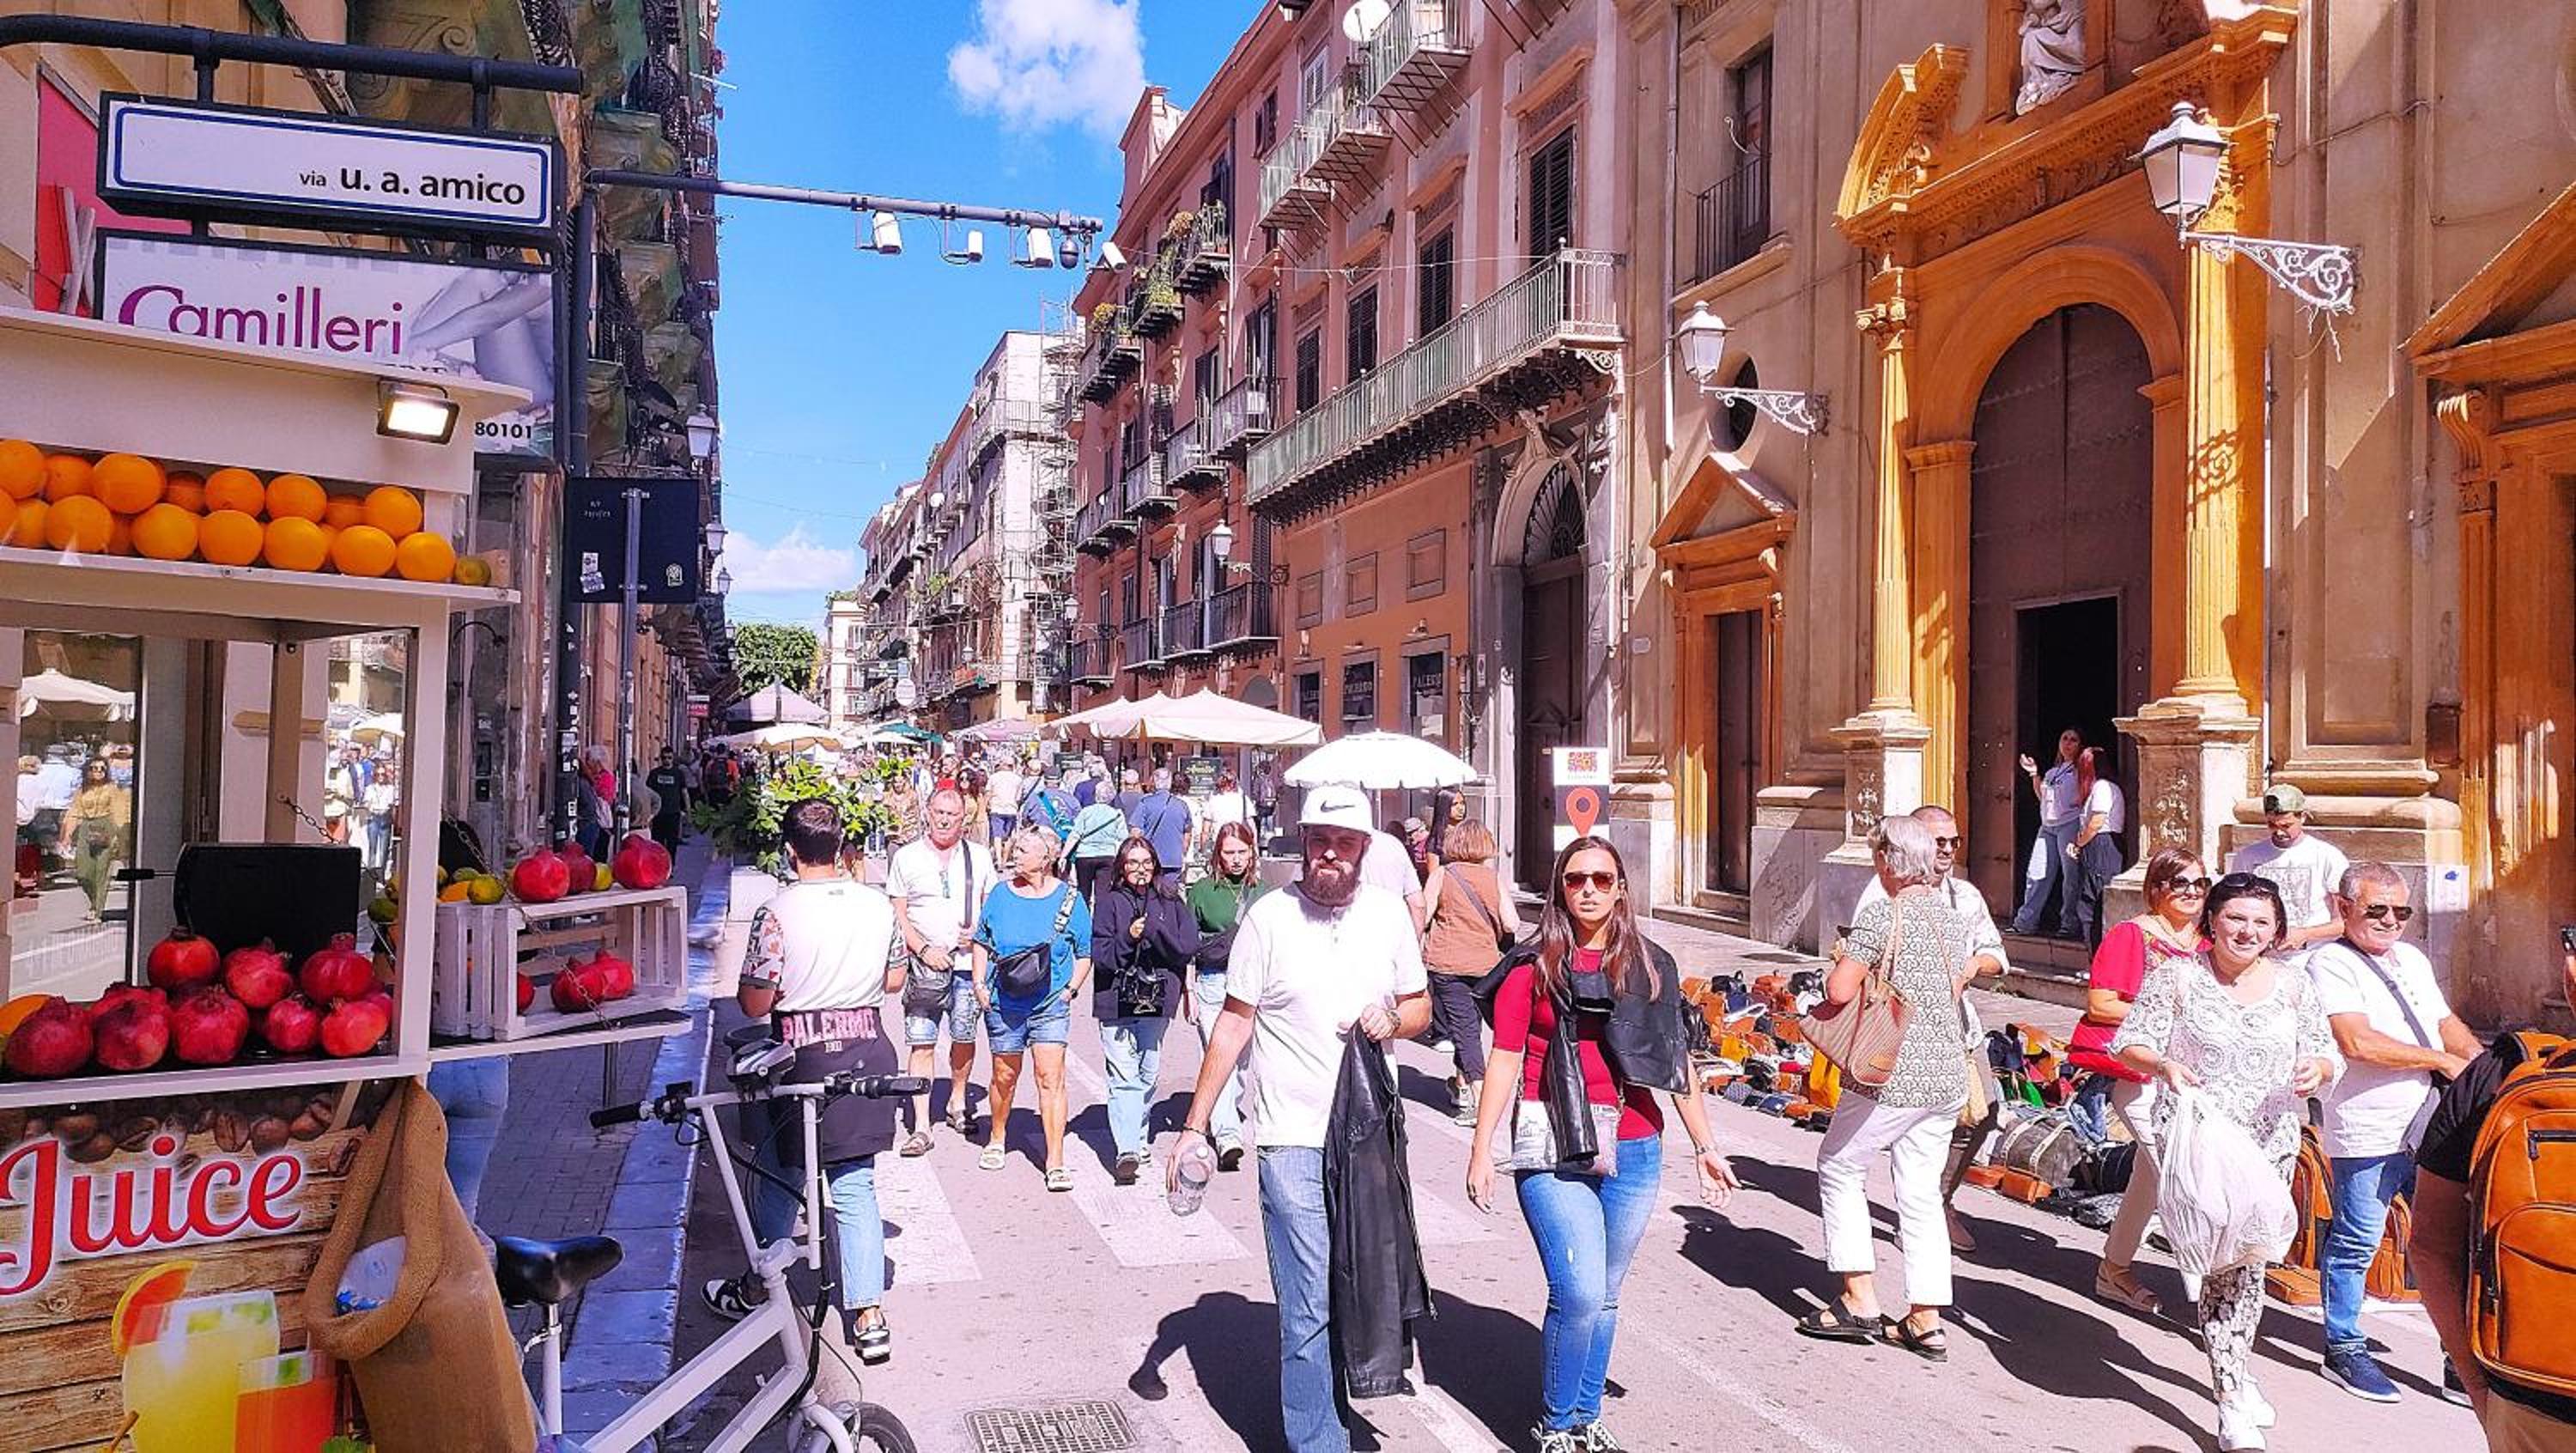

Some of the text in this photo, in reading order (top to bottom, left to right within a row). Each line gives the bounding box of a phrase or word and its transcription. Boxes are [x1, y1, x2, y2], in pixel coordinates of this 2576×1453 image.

[300, 167, 526, 205] via u. a. amico
[118, 284, 404, 355] Camilleri
[781, 1007, 878, 1048] PALERMO
[0, 1136, 302, 1296] Juice
